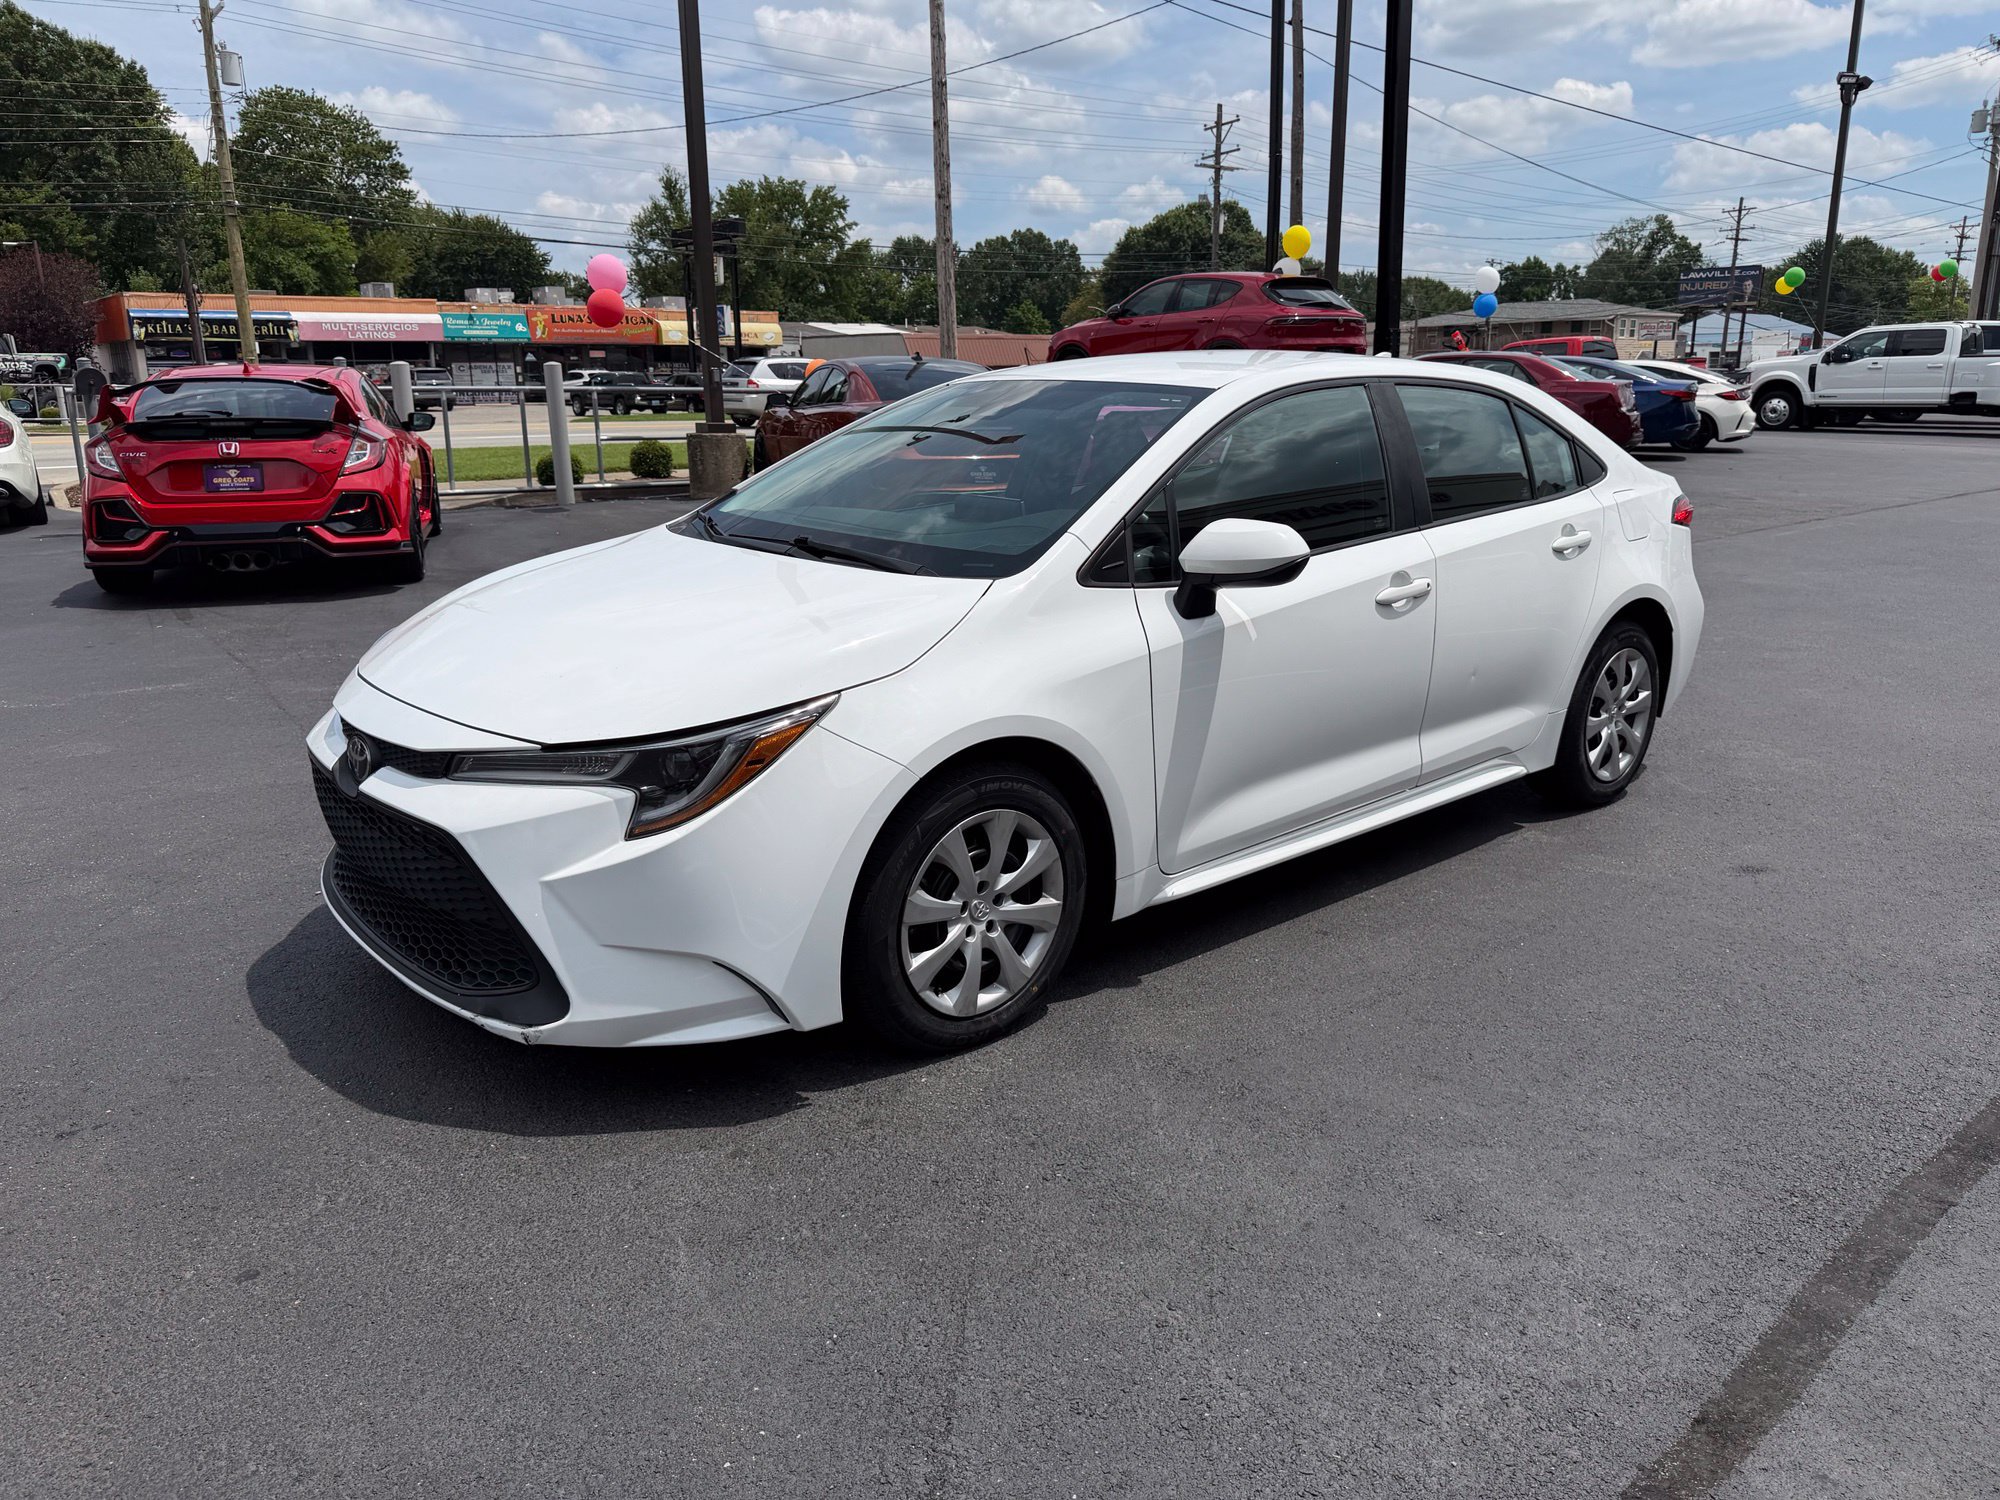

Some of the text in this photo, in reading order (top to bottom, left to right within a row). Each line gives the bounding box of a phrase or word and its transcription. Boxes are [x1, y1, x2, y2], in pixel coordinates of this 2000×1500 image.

[551, 313, 592, 324] LUNA'S
[212, 324, 238, 335] BAR
[253, 322, 287, 336] GRILL
[322, 323, 419, 332] MULTI-SERVICIOS
[348, 331, 397, 339] LATINOS
